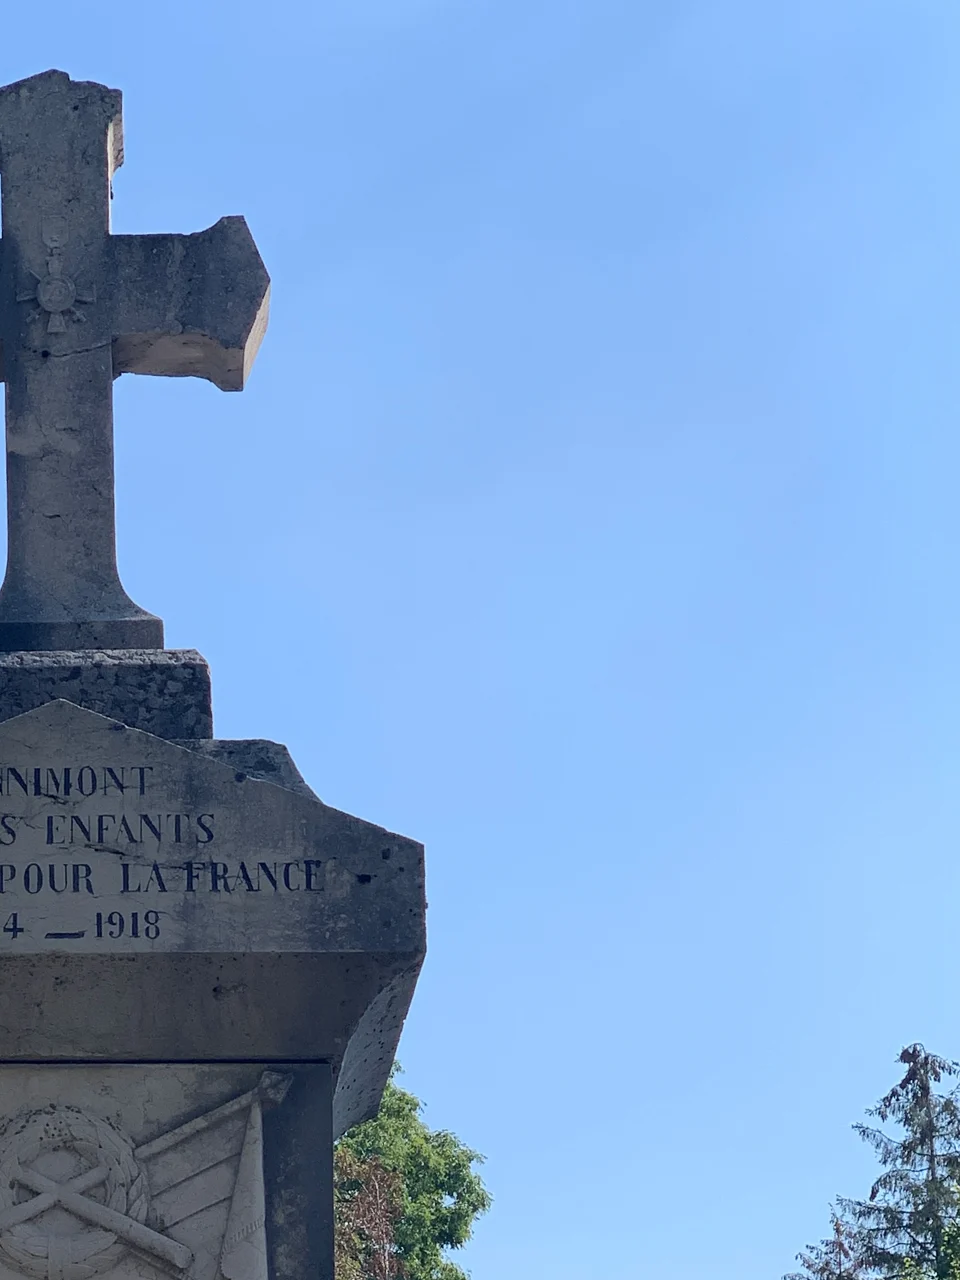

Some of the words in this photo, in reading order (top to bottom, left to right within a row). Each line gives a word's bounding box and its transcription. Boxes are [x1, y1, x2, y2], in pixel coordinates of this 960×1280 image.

[45, 813, 215, 846] ENFANTS
[119, 863, 175, 894] LA
[185, 862, 325, 894] FRANCE
[94, 910, 160, 940] 1918
